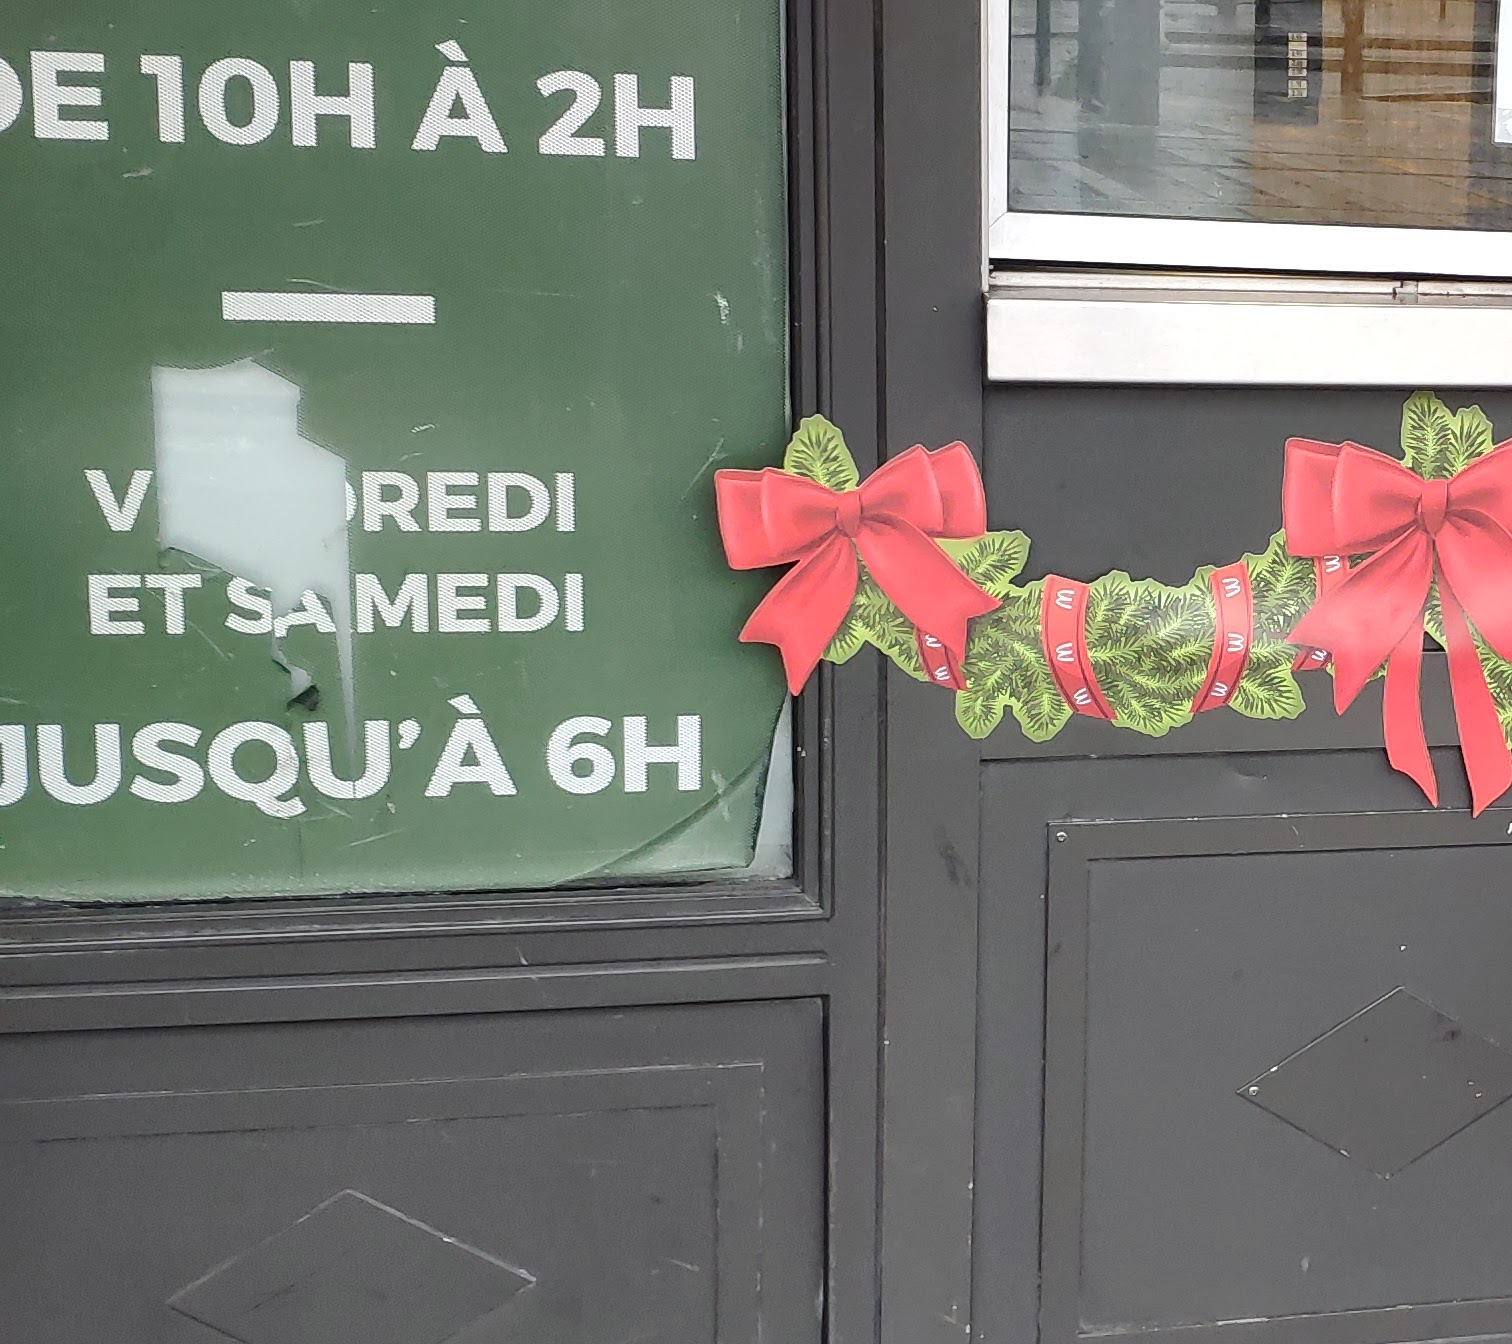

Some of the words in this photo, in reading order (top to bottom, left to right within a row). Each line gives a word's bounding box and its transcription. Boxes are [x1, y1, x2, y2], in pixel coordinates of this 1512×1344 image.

[140, 54, 377, 149] 10H
[410, 39, 508, 154] À
[536, 70, 697, 161] 2H
[84, 469, 577, 534] VREDI
[87, 573, 203, 635] ET
[544, 713, 704, 796] 6H
